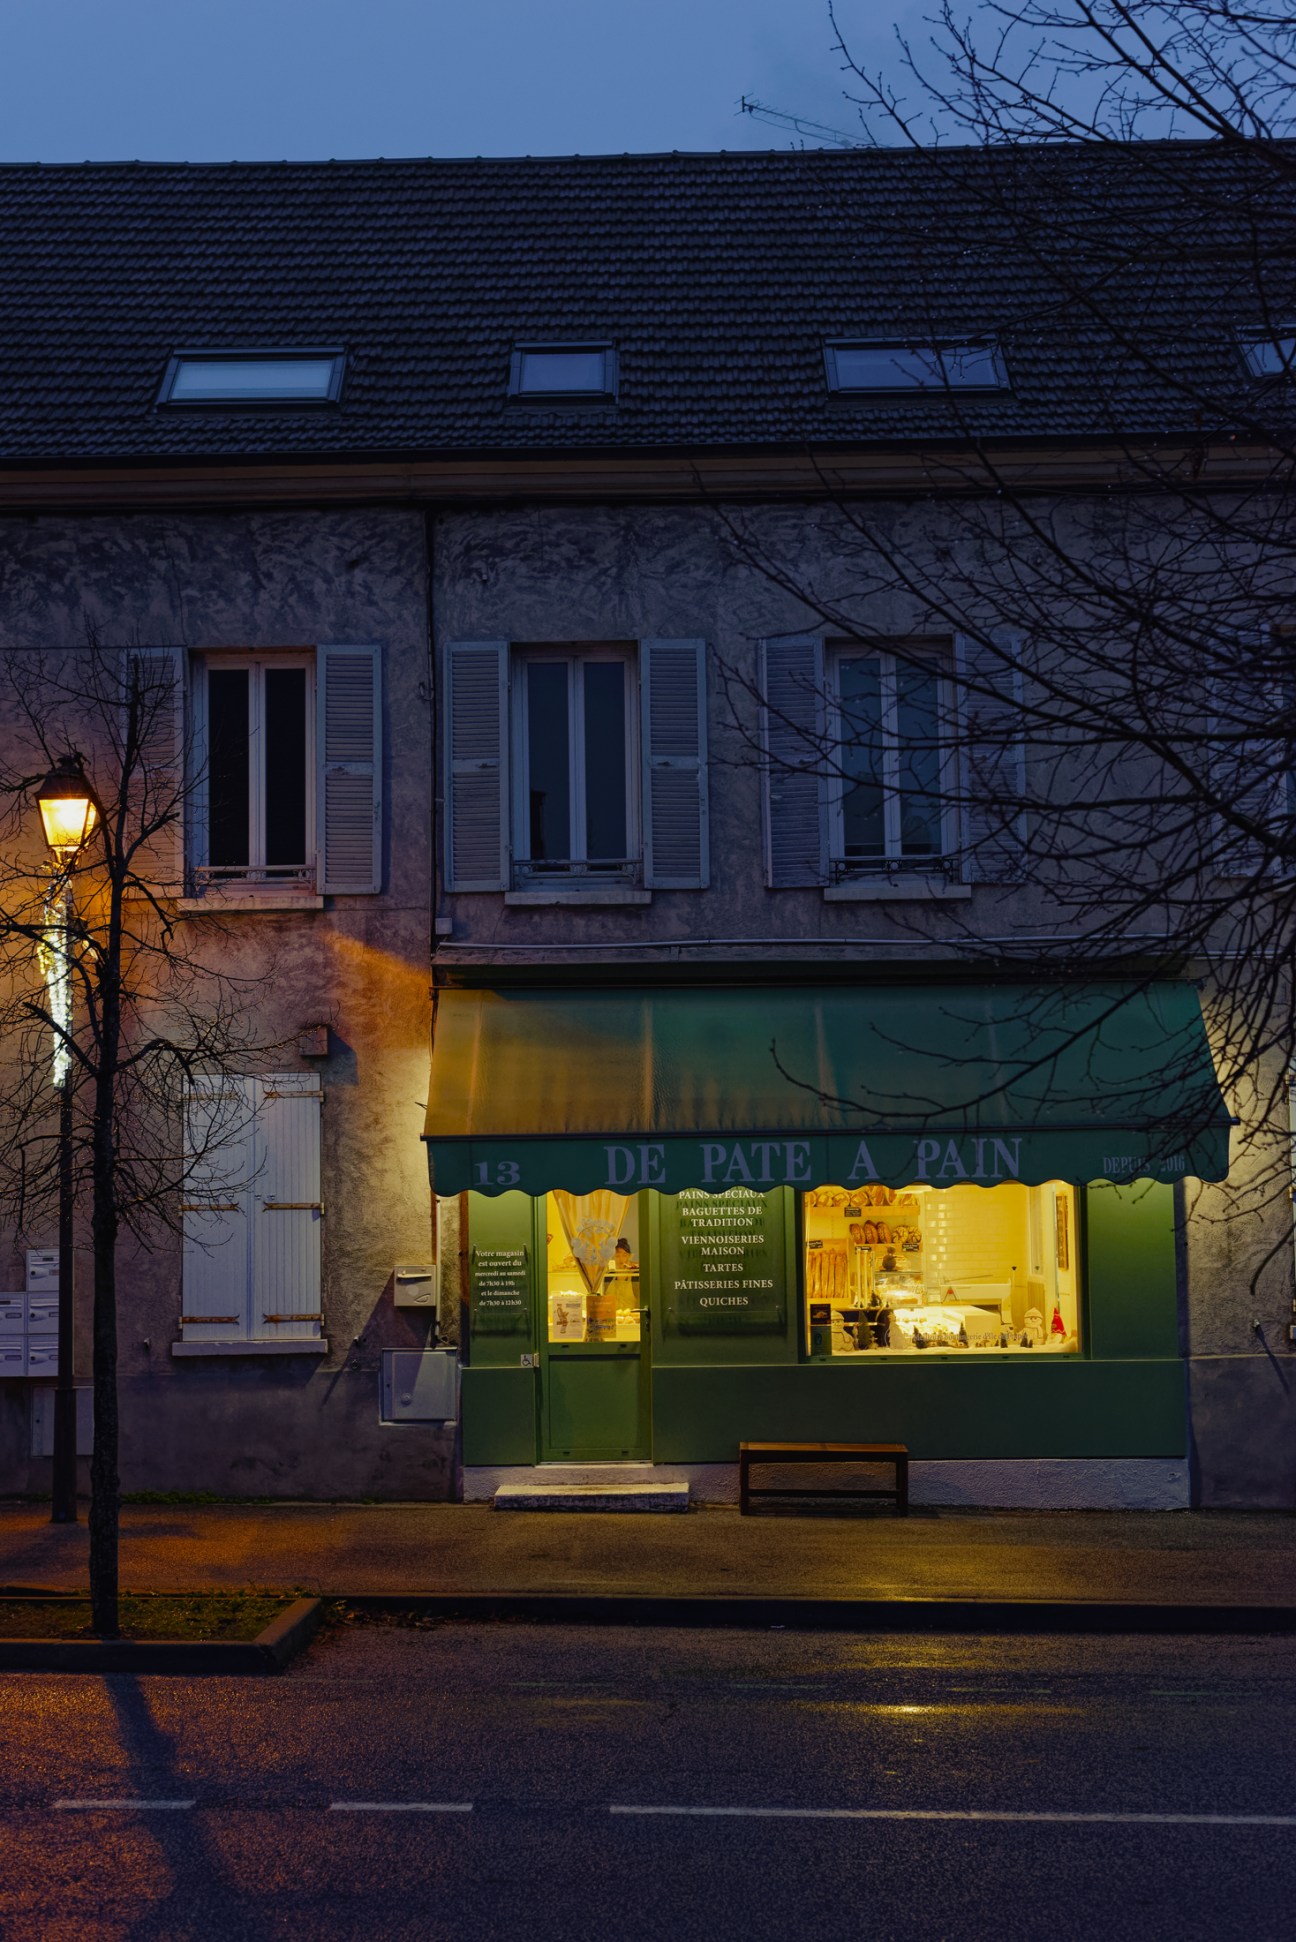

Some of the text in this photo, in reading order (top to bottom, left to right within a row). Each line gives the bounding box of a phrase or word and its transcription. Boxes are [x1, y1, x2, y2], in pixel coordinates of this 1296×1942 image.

[603, 1138, 1022, 1185] DE PATE A PAIN
[1103, 1156, 1151, 1174] DEPUIS
[474, 1161, 521, 1186] 13
[679, 1190, 710, 1199] PAINS
[682, 1206, 762, 1216] BAGUETTES DE
[691, 1218, 753, 1227] TRADITION
[681, 1235, 764, 1244] VIENNOISERIES
[496, 1250, 524, 1258] magasin
[701, 1247, 744, 1256] MAISON
[703, 1263, 743, 1272] TARTES
[674, 1279, 773, 1289] PÂTISSERIES FINES
[700, 1297, 749, 1307] QUICHES
